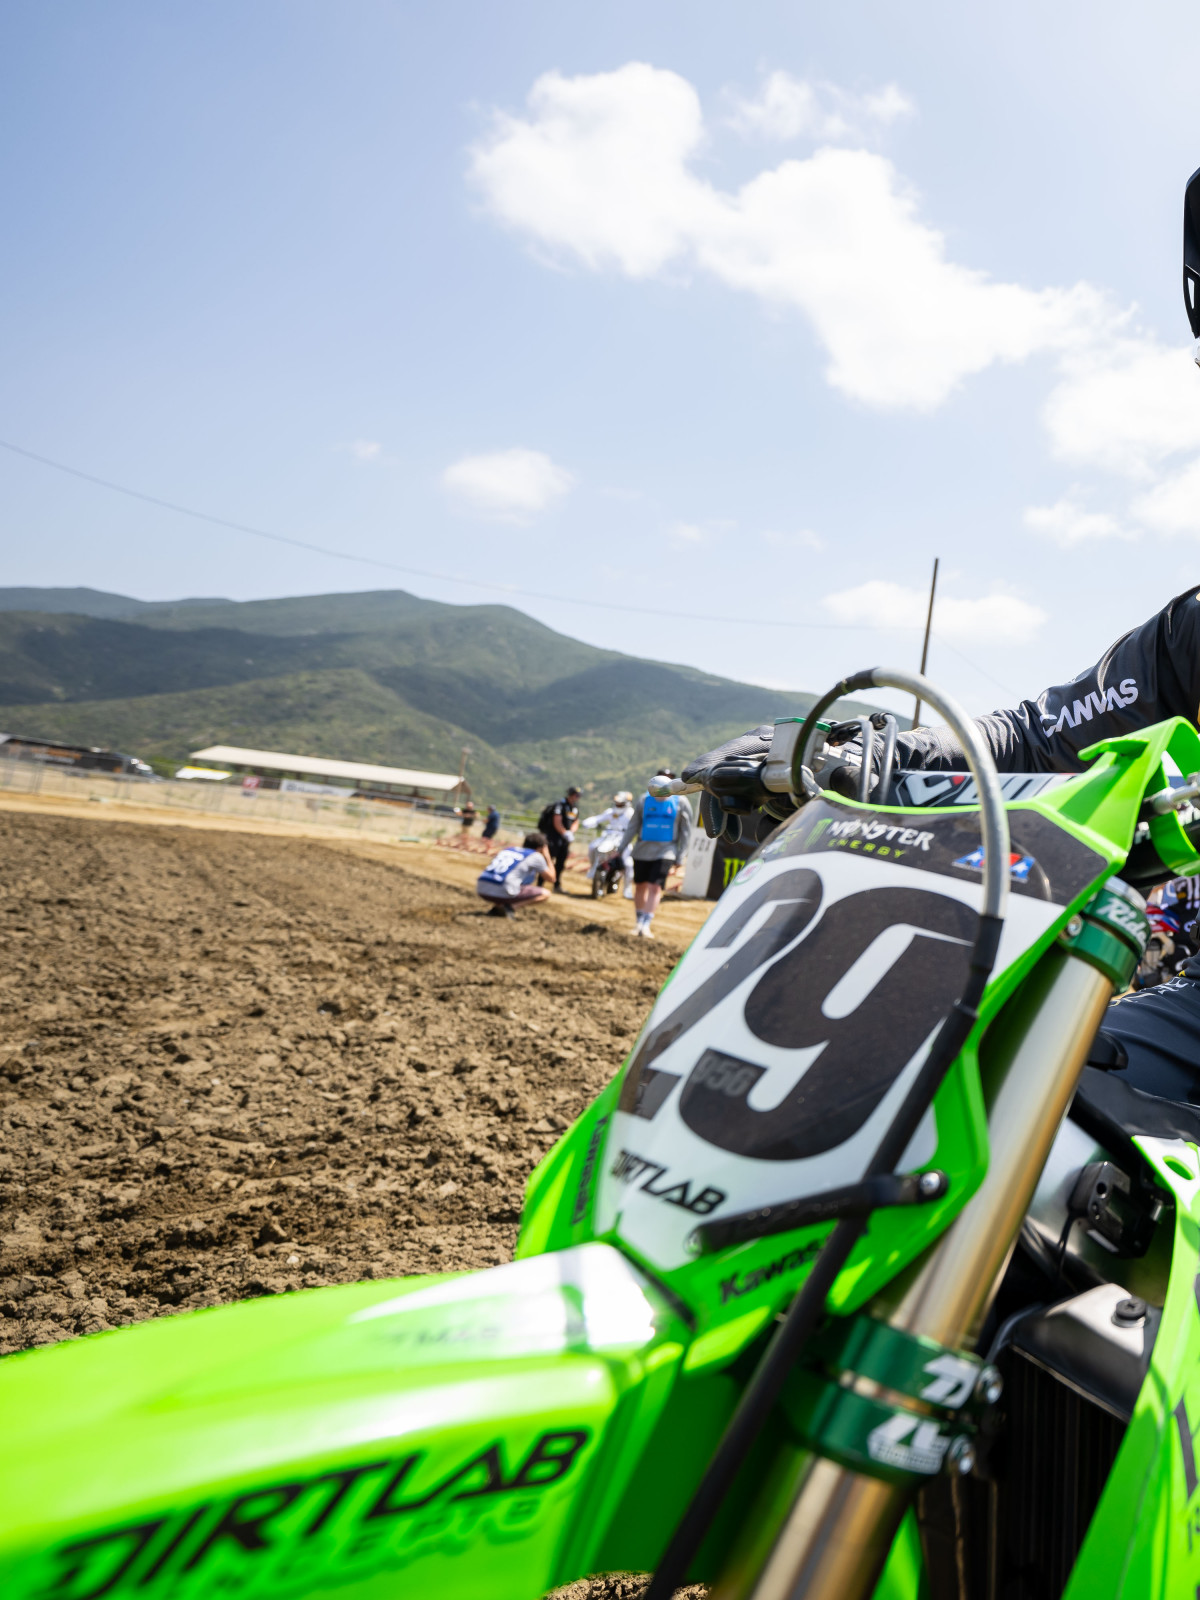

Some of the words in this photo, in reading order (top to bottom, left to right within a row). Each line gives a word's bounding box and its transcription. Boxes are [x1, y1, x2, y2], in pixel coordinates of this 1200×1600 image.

[1039, 678, 1139, 738] CANVAS
[826, 818, 935, 851] MONSTER
[827, 838, 905, 859] ENERGY
[1096, 897, 1147, 952] Ride
[617, 868, 984, 1162] 29
[55, 1430, 590, 1600] DIRTLAB
